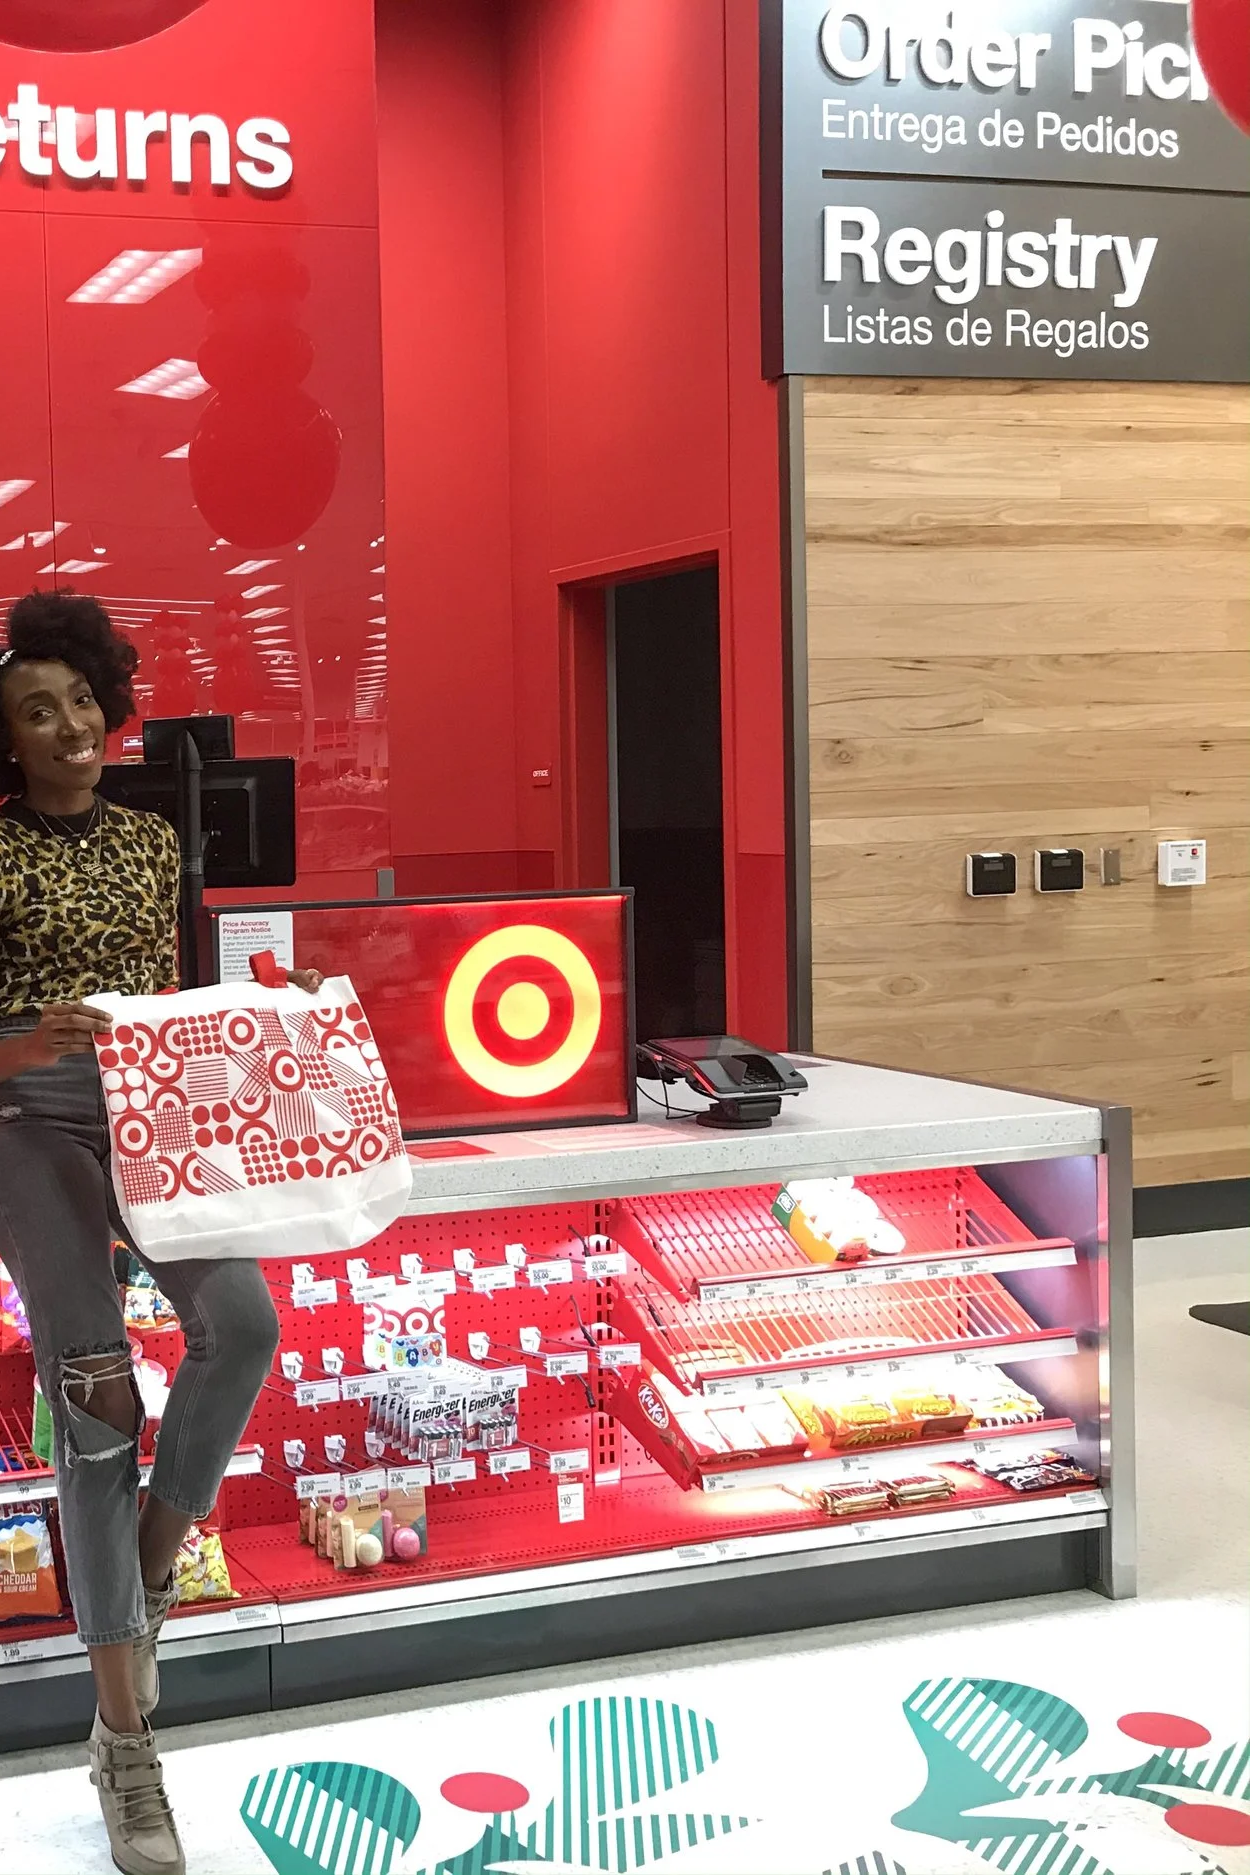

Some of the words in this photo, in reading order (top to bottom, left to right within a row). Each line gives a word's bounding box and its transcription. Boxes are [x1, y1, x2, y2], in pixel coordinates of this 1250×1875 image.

[821, 4, 1050, 89] Order
[822, 99, 967, 154] Entrega
[978, 110, 1025, 149] de
[1036, 112, 1179, 158] Pedidos
[823, 205, 1158, 308] Registry
[823, 305, 933, 345] Listas
[946, 311, 992, 347] de
[1006, 309, 1149, 359] Regalos
[412, 1398, 461, 1423] Energizer
[468, 1387, 516, 1413] Energizer
[19, 1584, 37, 1592] CREAM
[3, 1649, 20, 1658] 1.89
